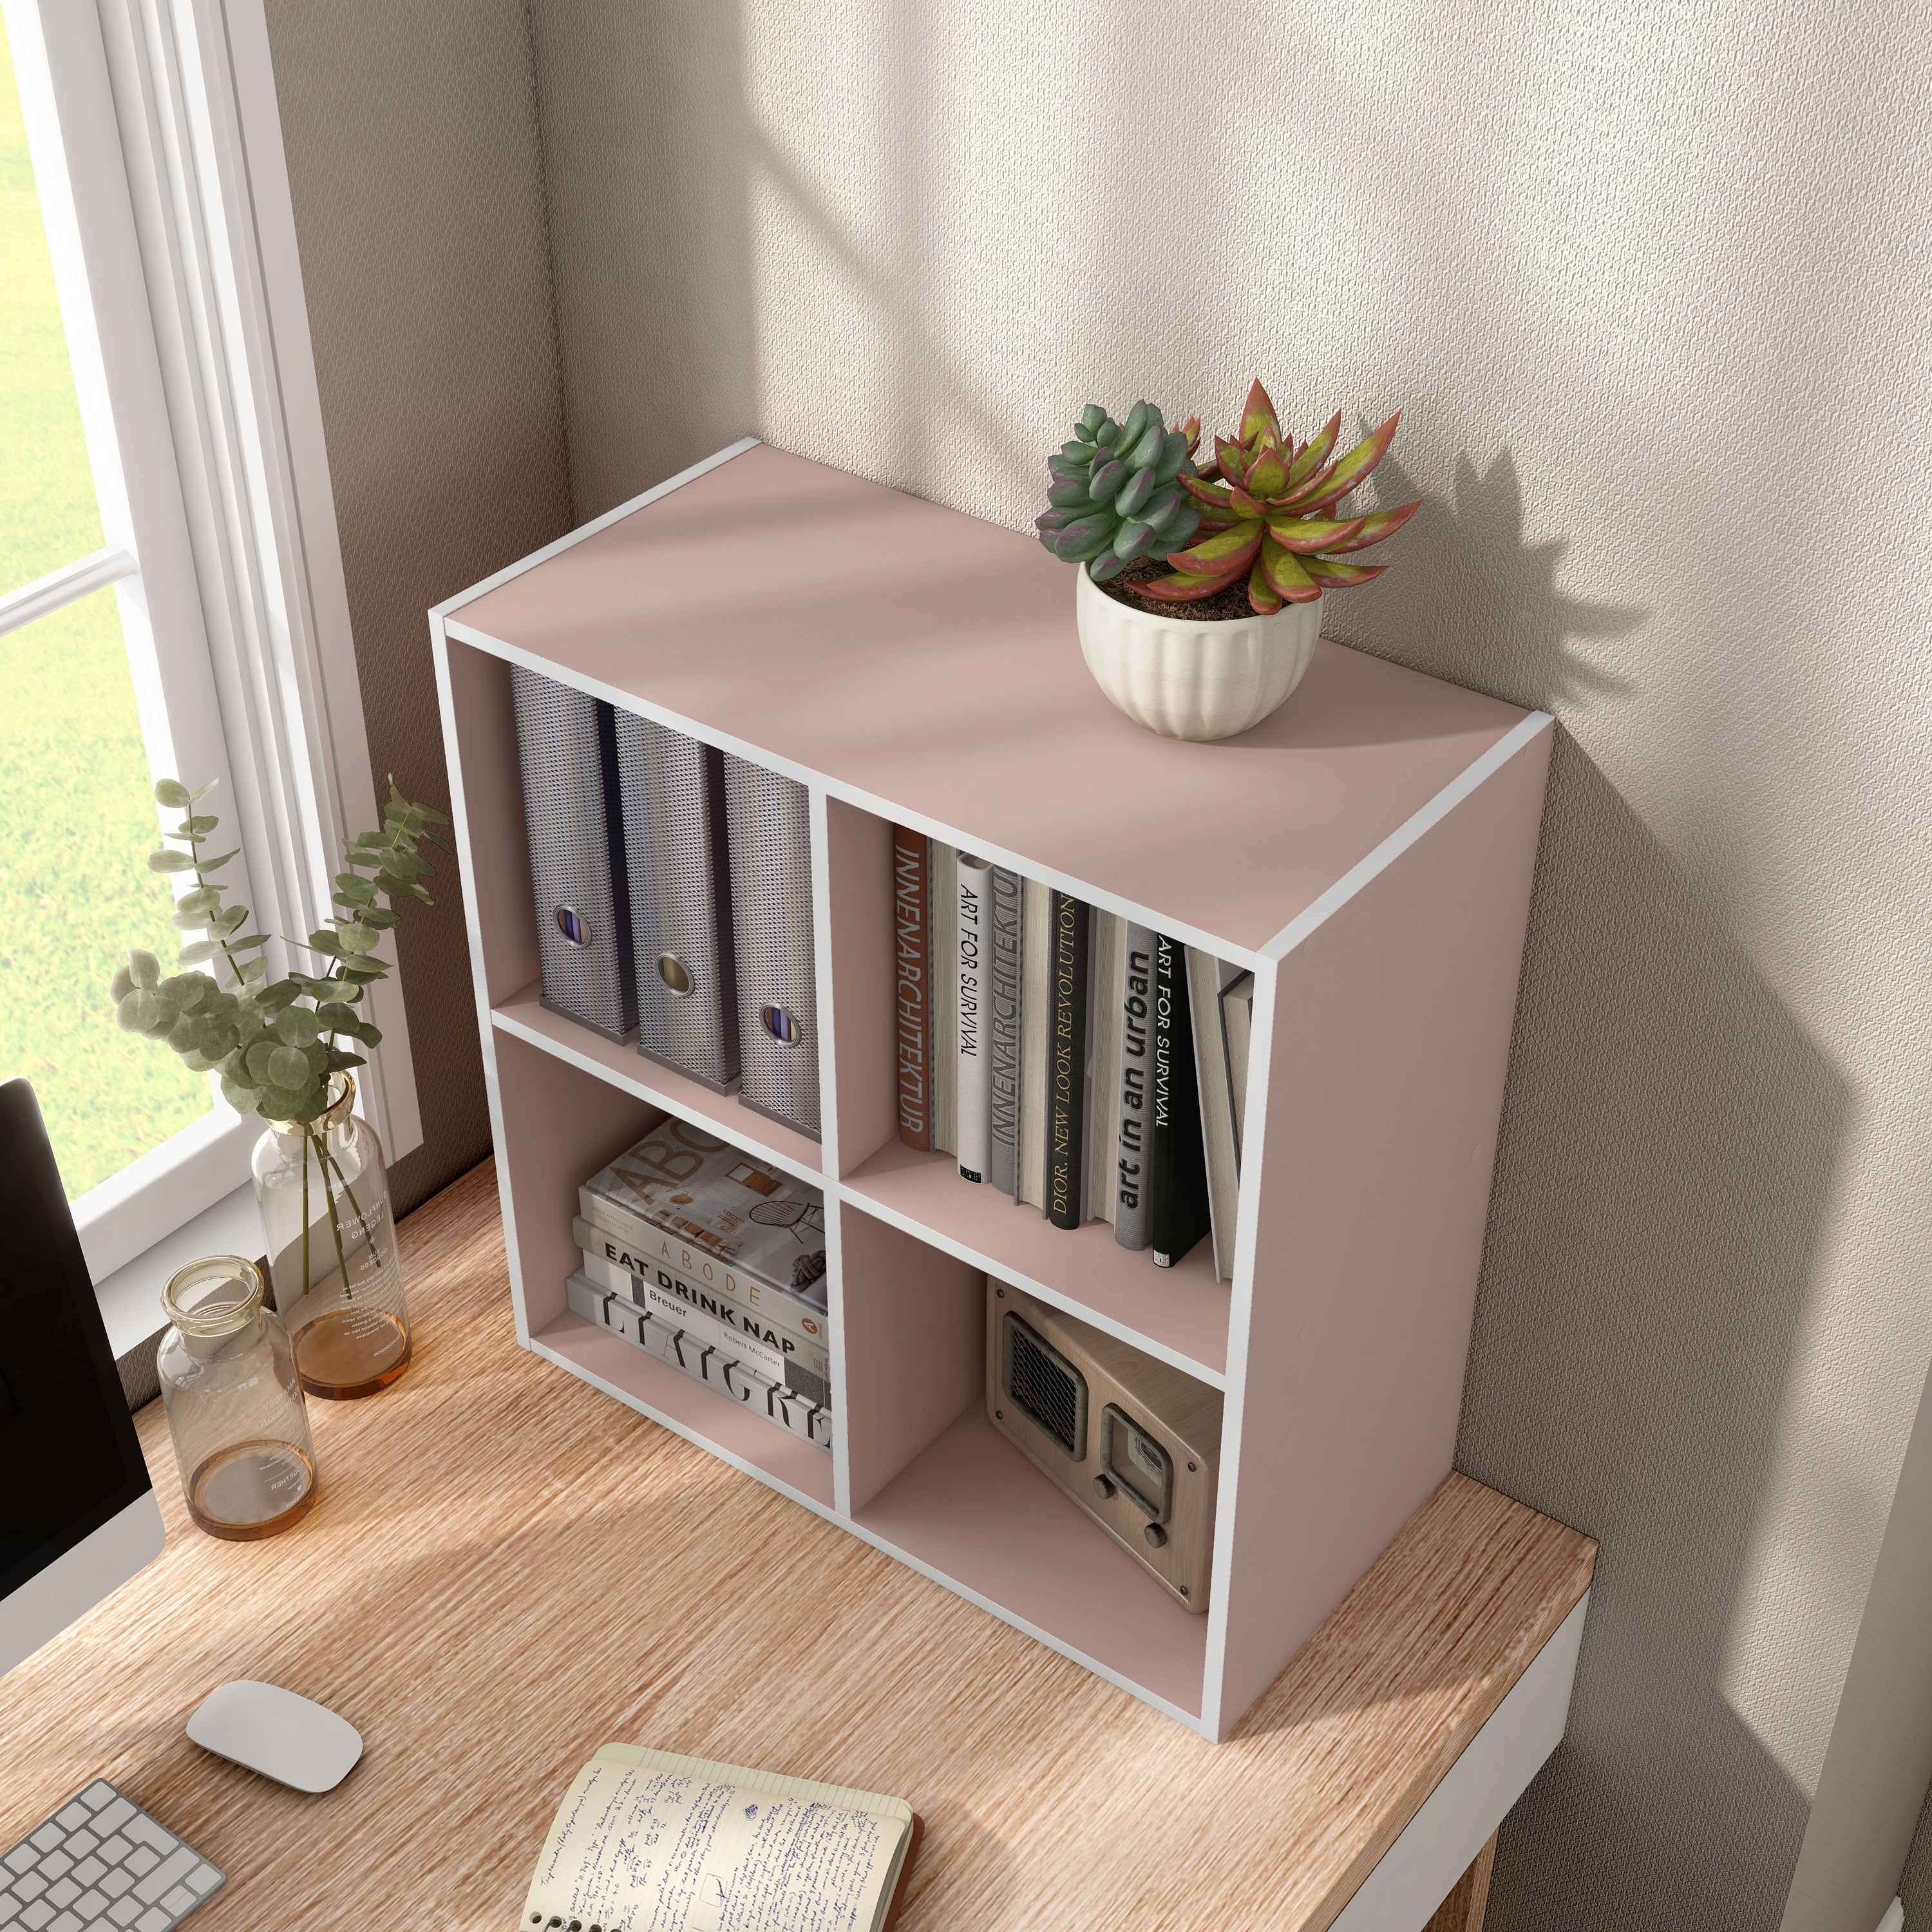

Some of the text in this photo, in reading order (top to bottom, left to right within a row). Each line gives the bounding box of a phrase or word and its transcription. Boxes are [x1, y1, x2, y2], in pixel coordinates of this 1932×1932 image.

[895, 844, 923, 1133] INNENARCHITEKTUR
[960, 883, 979, 1056] ART FOR SURVIVAL
[993, 864, 1018, 1147] INNENARCHITEKTU
[1054, 893, 1075, 1215] DIOR. NEW LOOK REVOLUTION
[1156, 934, 1172, 1126] ART FOR SURVIVAL
[1119, 951, 1150, 1209] art in an urban
[605, 1242, 796, 1354] EAT DRINK NAP
[649, 1289, 688, 1318] Breuer
[661, 1240, 761, 1307] ABODE
[723, 1332, 781, 1368] Robert McCarter
[602, 1291, 831, 1449] LIAIGRE
